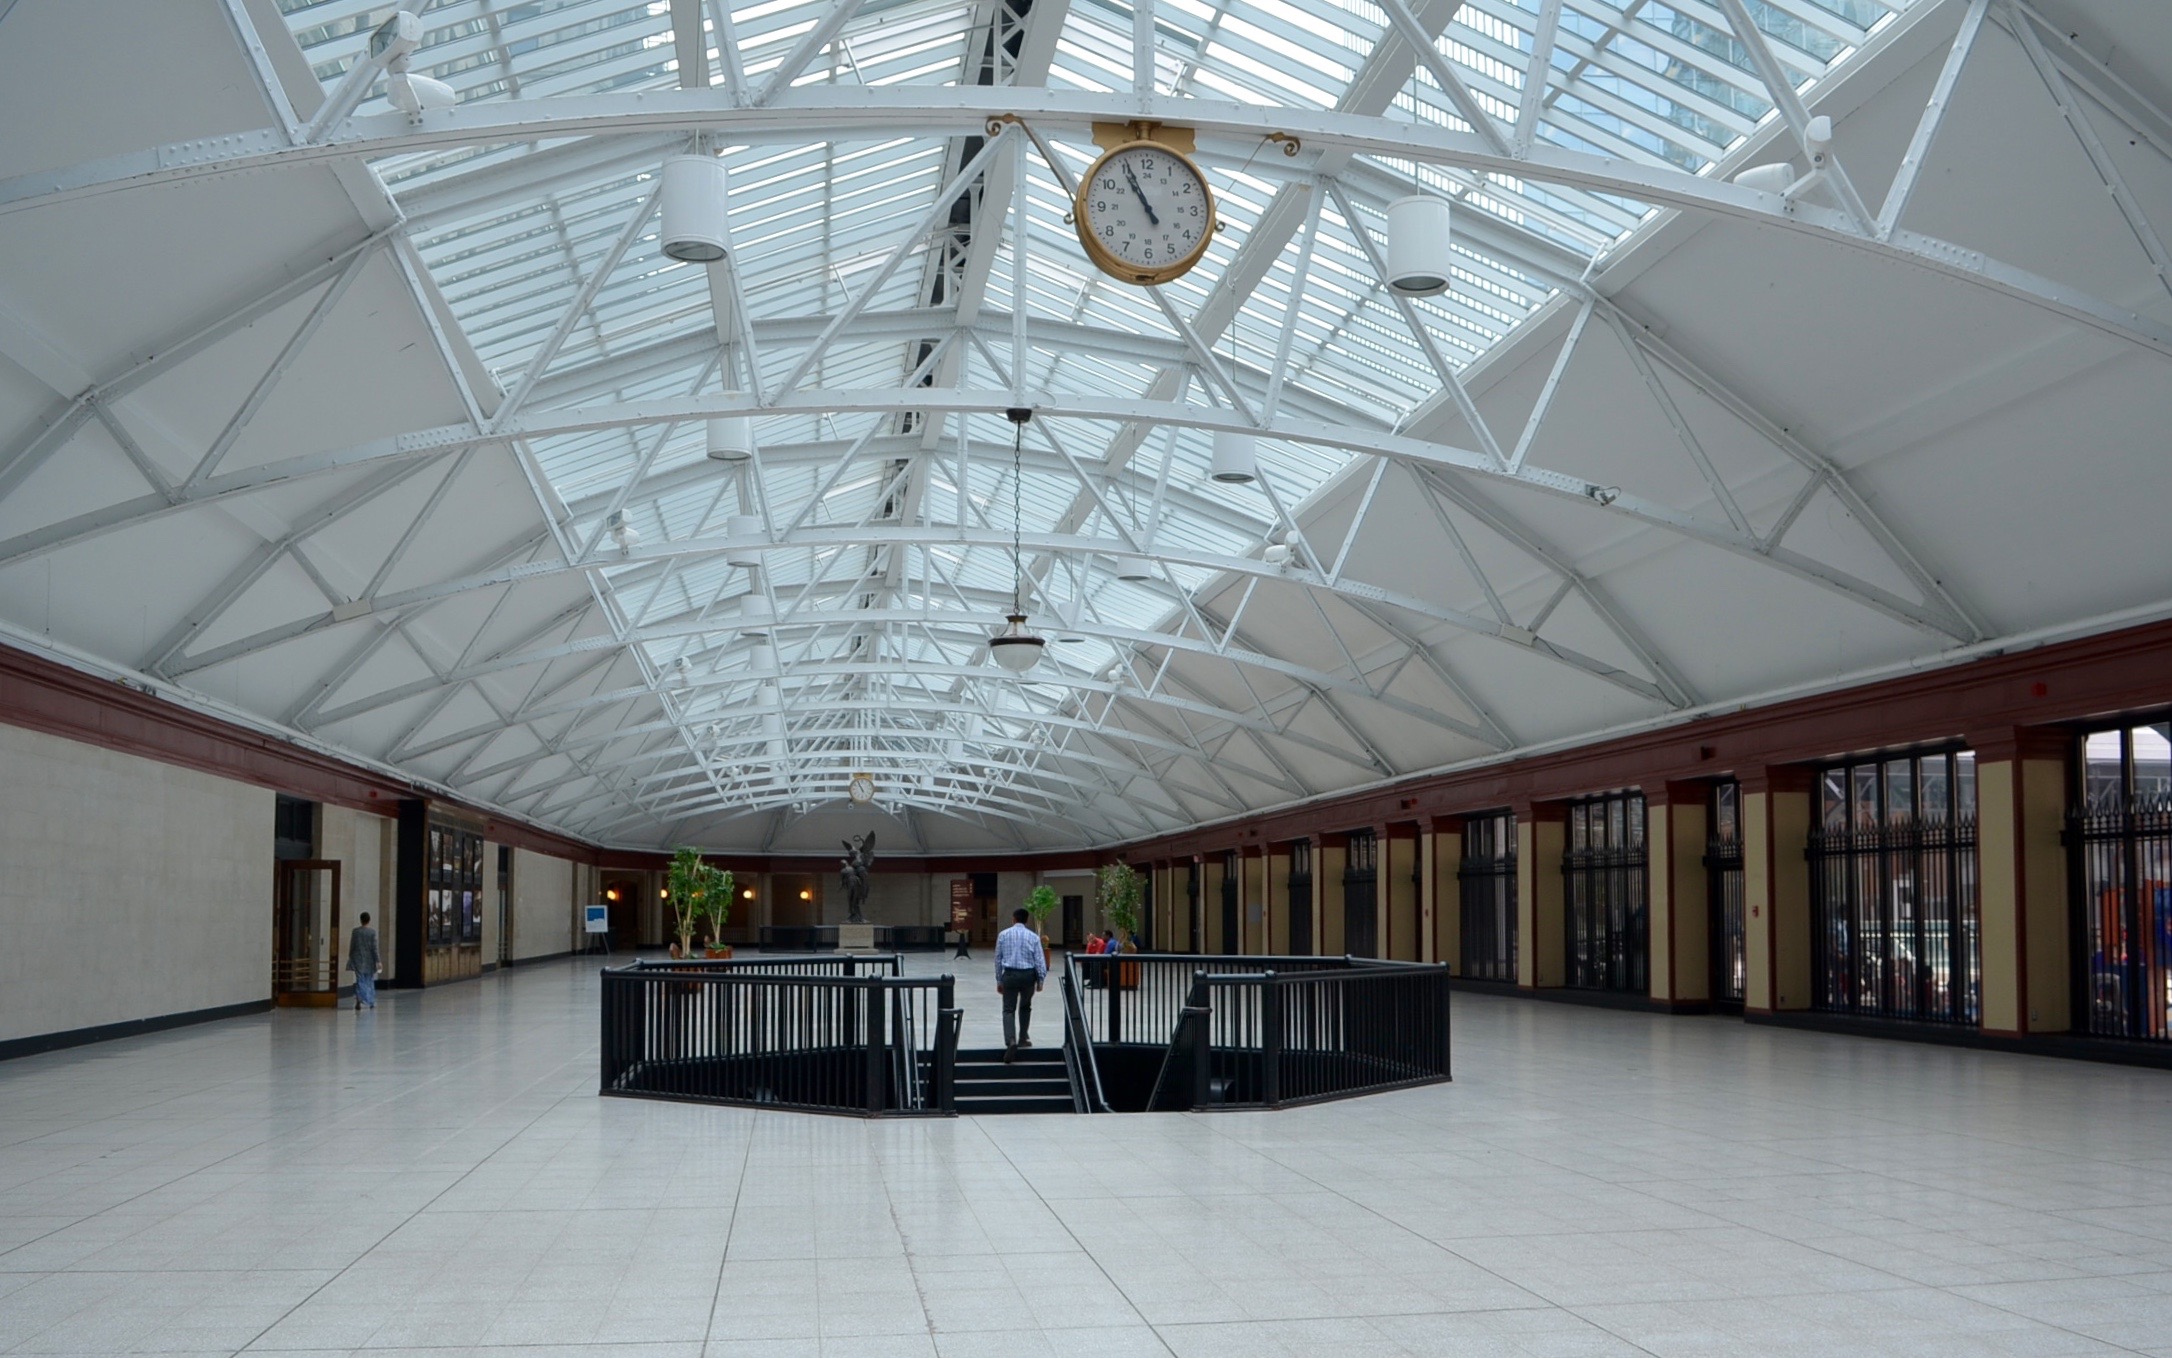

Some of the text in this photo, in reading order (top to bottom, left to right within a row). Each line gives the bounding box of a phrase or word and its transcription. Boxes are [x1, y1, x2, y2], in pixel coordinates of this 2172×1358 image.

[1141, 158, 1154, 170] 12
[1167, 165, 1172, 177] 1
[1103, 178, 1116, 190] 10
[1182, 182, 1191, 194] 2
[1116, 187, 1125, 195] 22
[1097, 200, 1106, 213] 9
[1111, 203, 1119, 211] 21
[1176, 206, 1185, 214] 15
[1189, 205, 1199, 217] 3
[1116, 219, 1126, 227] 20
[1172, 222, 1181, 230] 16
[1105, 224, 1114, 237] 8
[1182, 229, 1191, 241] 4
[1121, 240, 1131, 252] 7
[1166, 242, 1176, 255] 5
[1143, 247, 1154, 260] 6
